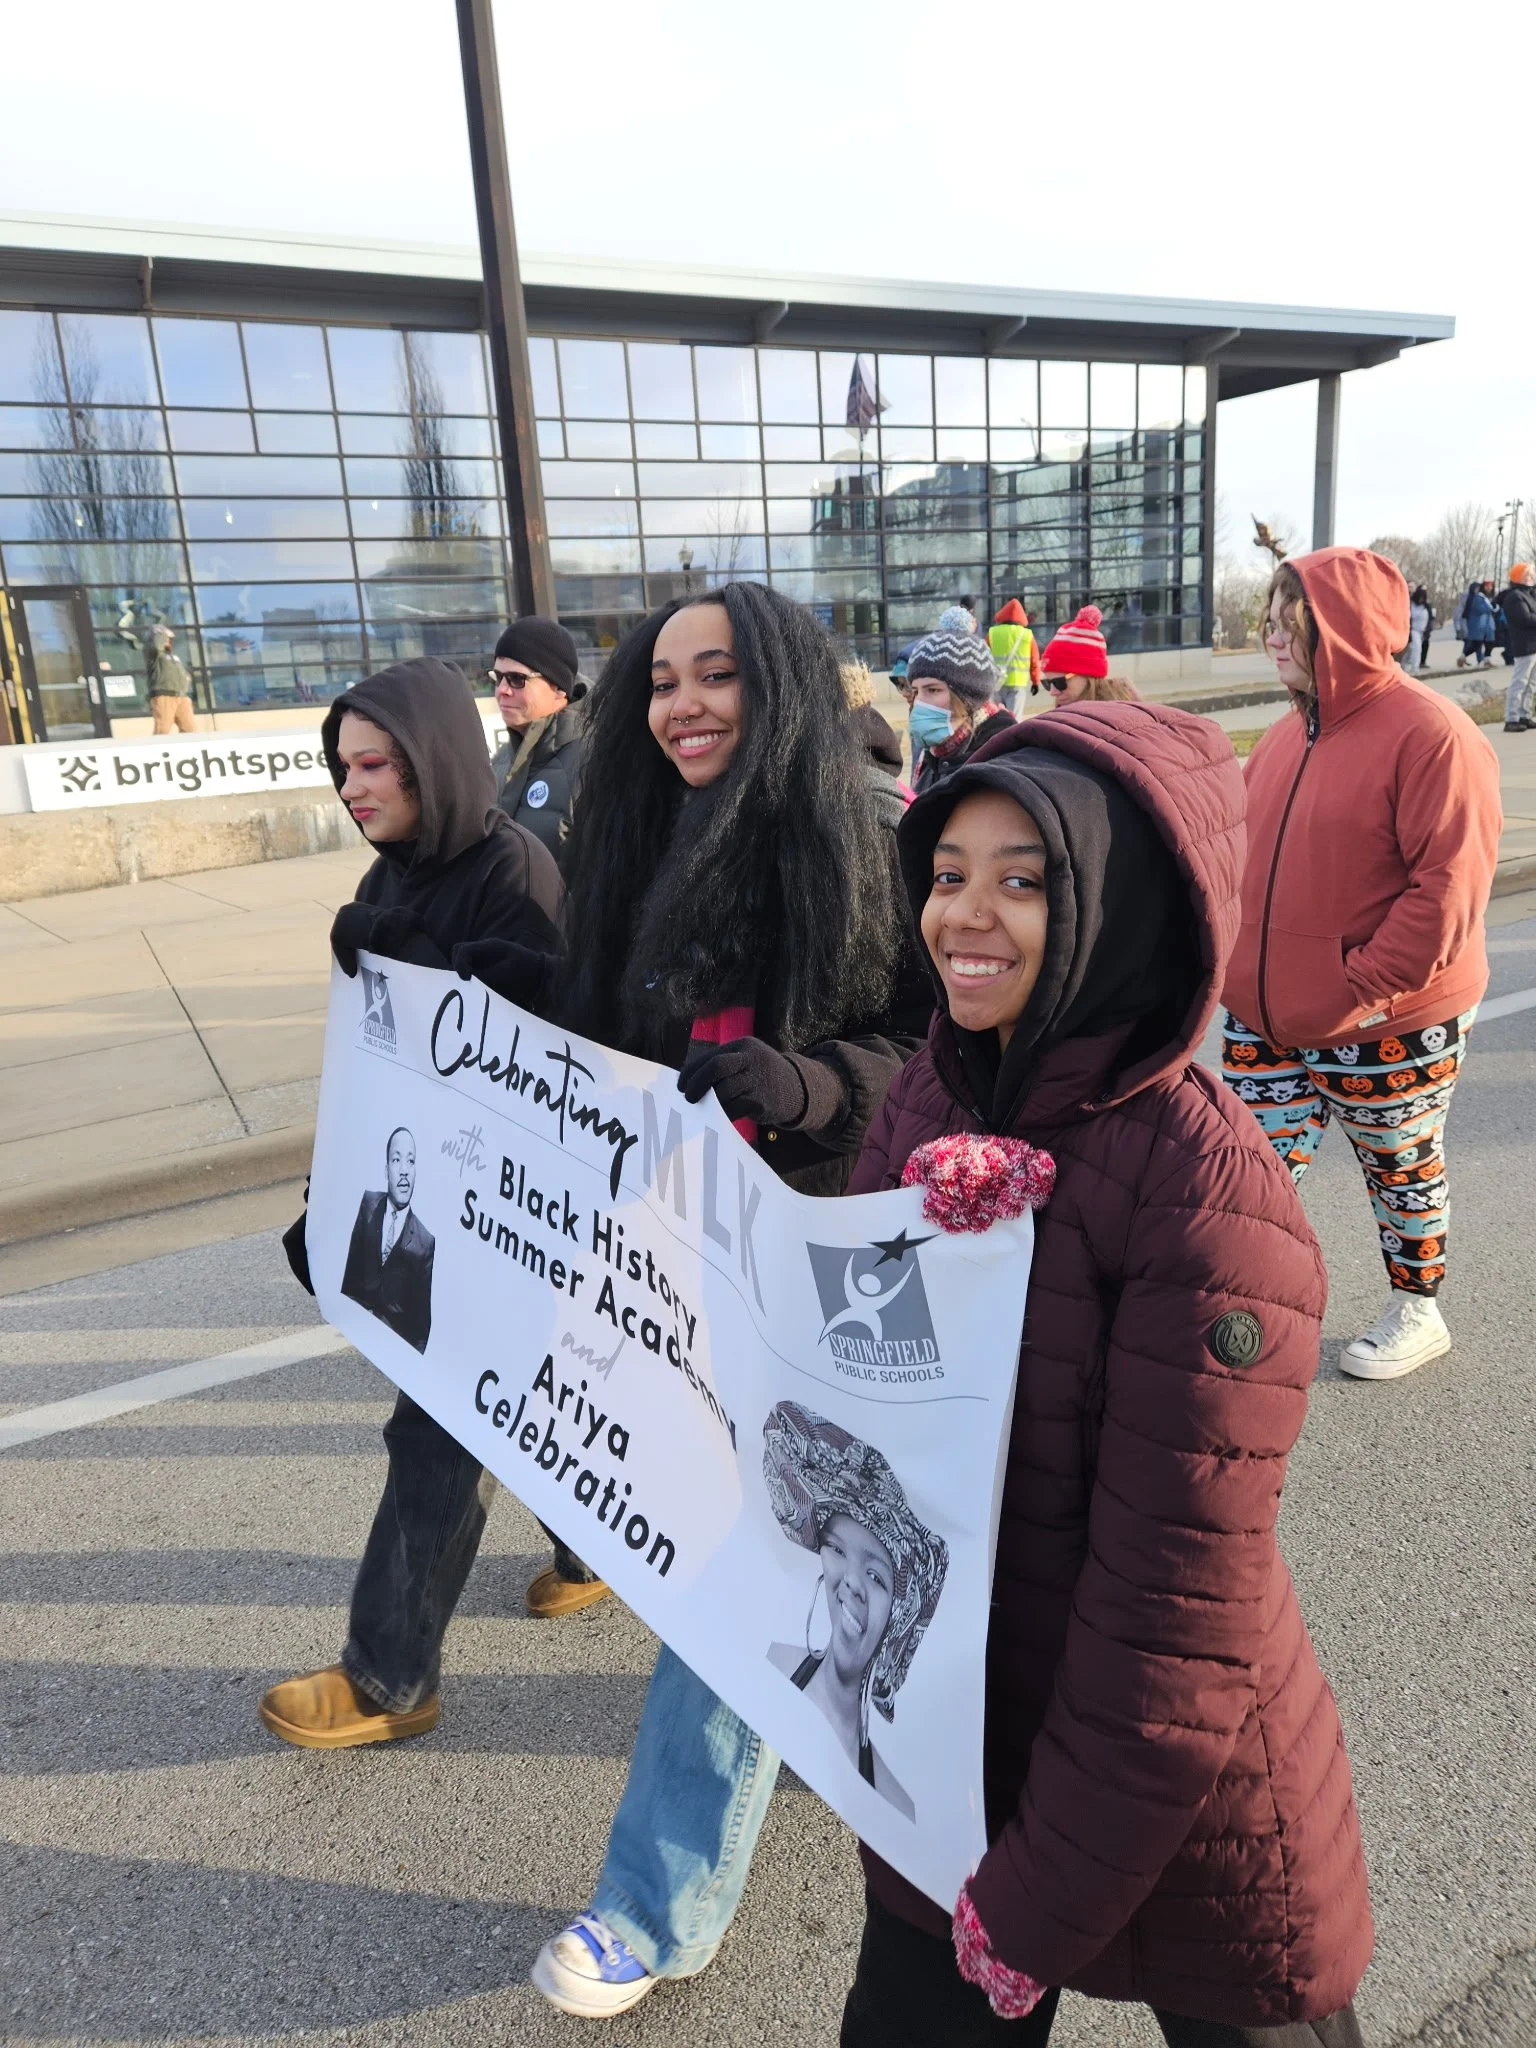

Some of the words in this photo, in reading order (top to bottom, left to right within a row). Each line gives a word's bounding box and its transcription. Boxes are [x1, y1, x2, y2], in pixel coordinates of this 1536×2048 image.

[114, 749, 328, 791] brightspee
[430, 989, 638, 1202] Celebrating
[642, 1088, 767, 1318] MLK
[441, 1124, 487, 1179] with
[499, 1155, 580, 1243] Black
[592, 1209, 697, 1352] History
[460, 1188, 585, 1299] Summer
[594, 1275, 738, 1454] Academy
[560, 1330, 627, 1383] and
[829, 1332, 936, 1366] SPRINGFIELD
[532, 1353, 631, 1463] Ariya
[834, 1360, 877, 1382] PUBLIC
[879, 1366, 945, 1384] SCHOOLS
[474, 1368, 677, 1578] Celebration
